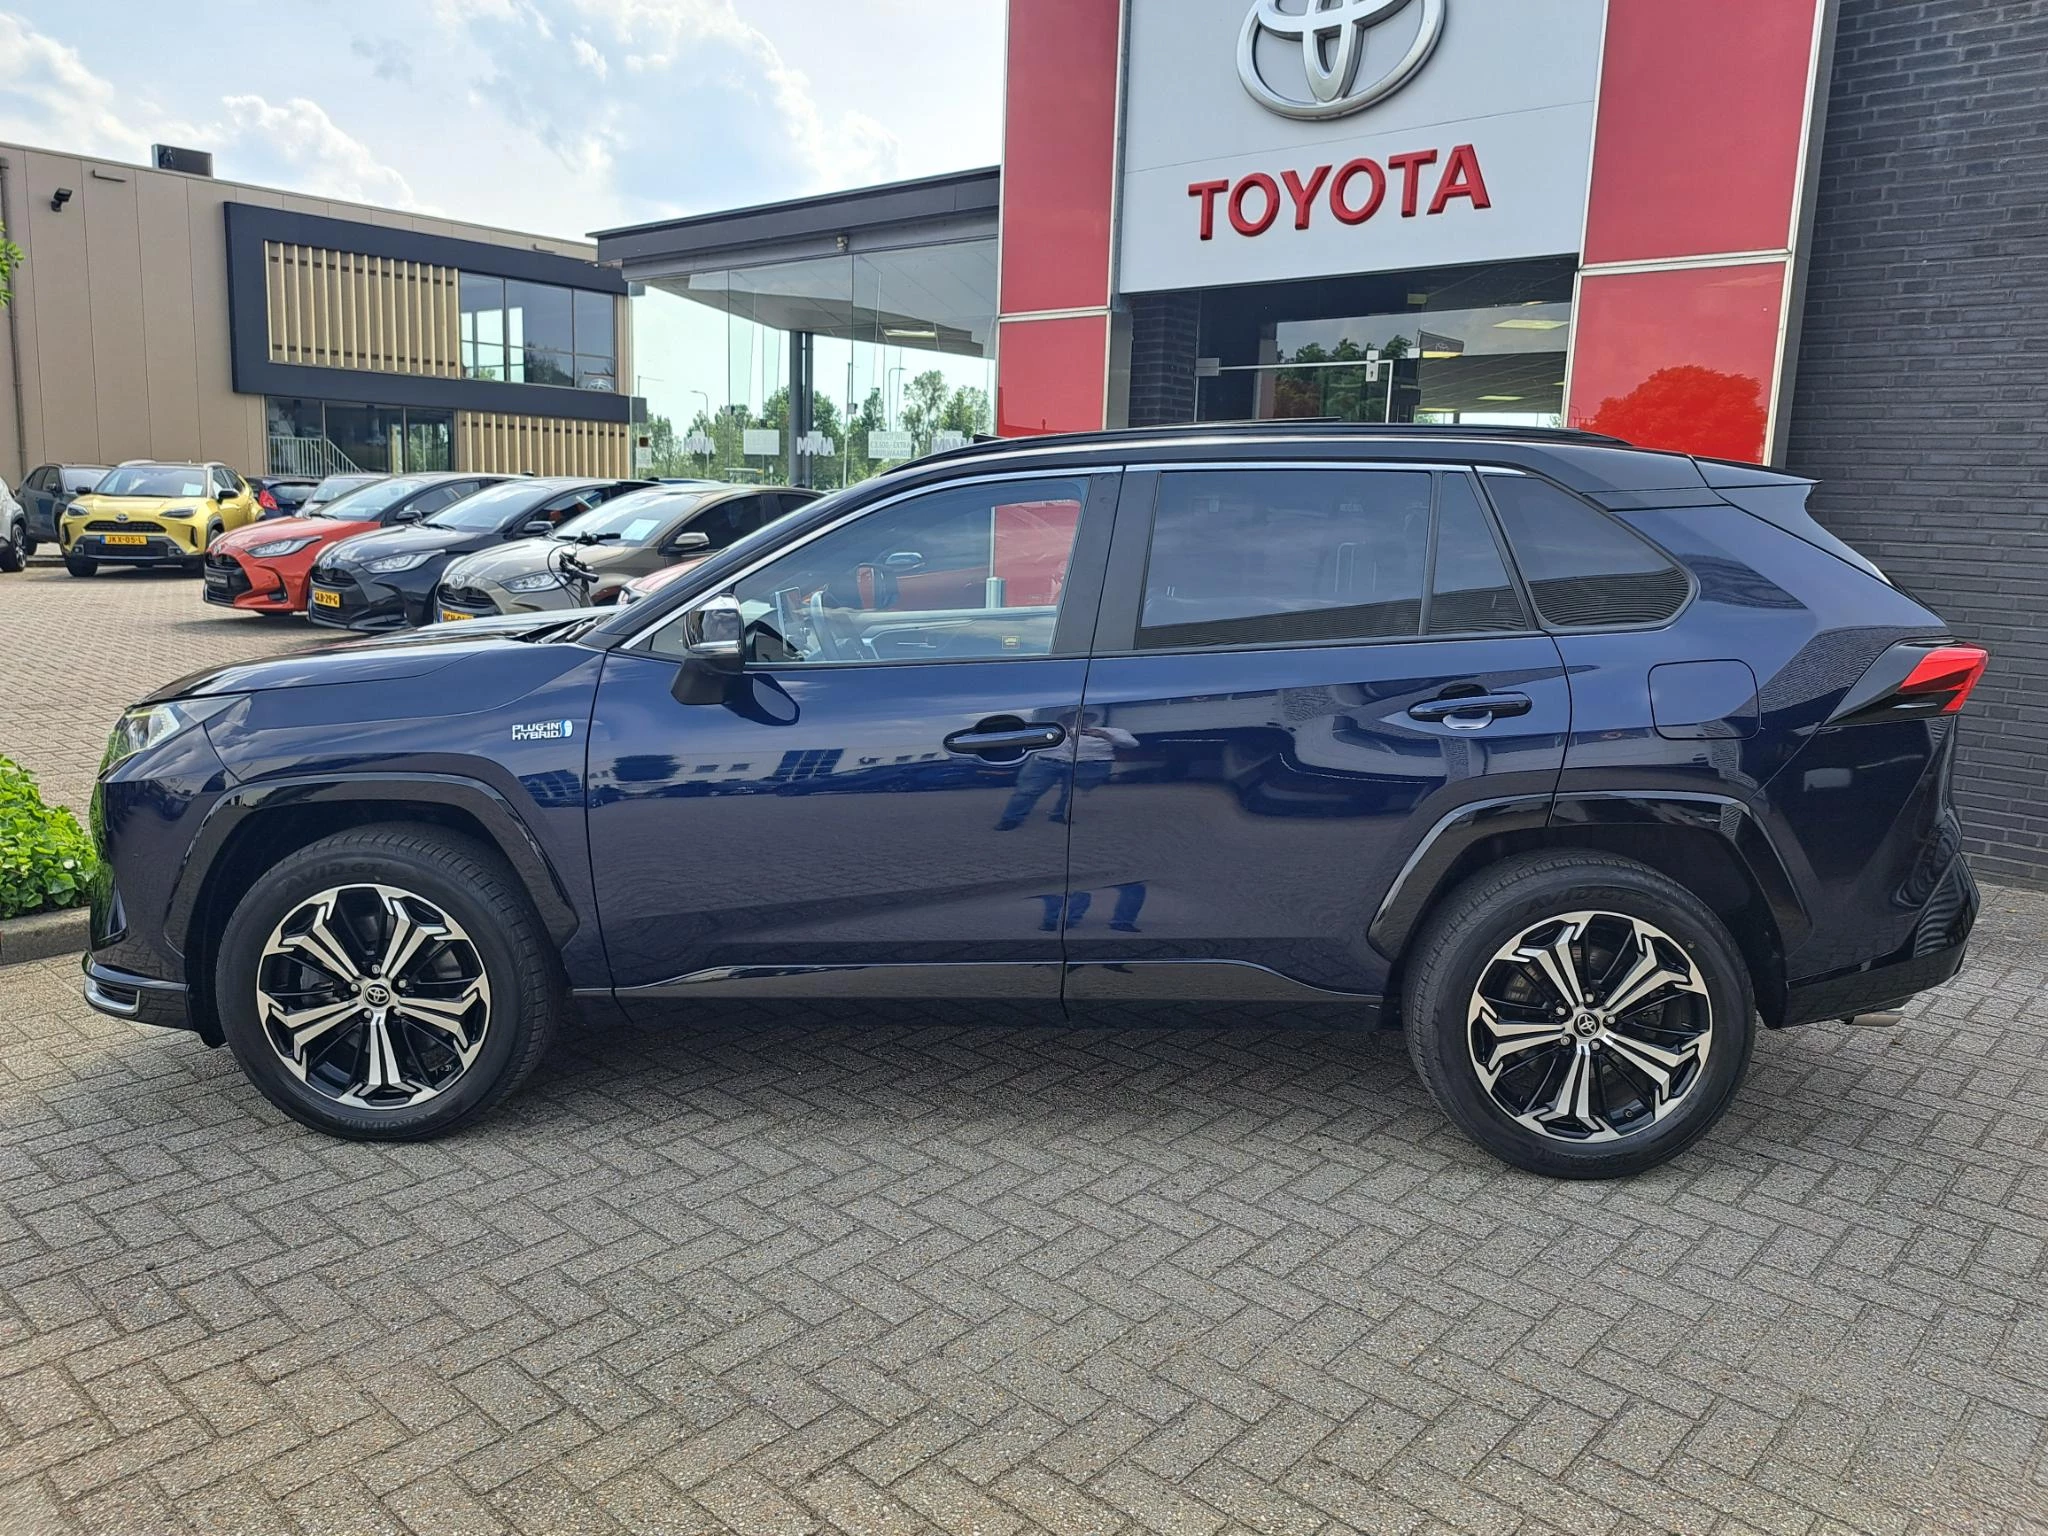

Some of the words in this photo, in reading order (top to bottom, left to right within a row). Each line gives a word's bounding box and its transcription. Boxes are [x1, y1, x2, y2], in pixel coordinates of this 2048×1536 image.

[1188, 143, 1491, 240] TOYOTA
[512, 722, 562, 733] PLUG-IN
[512, 730, 561, 740] HYBRID
